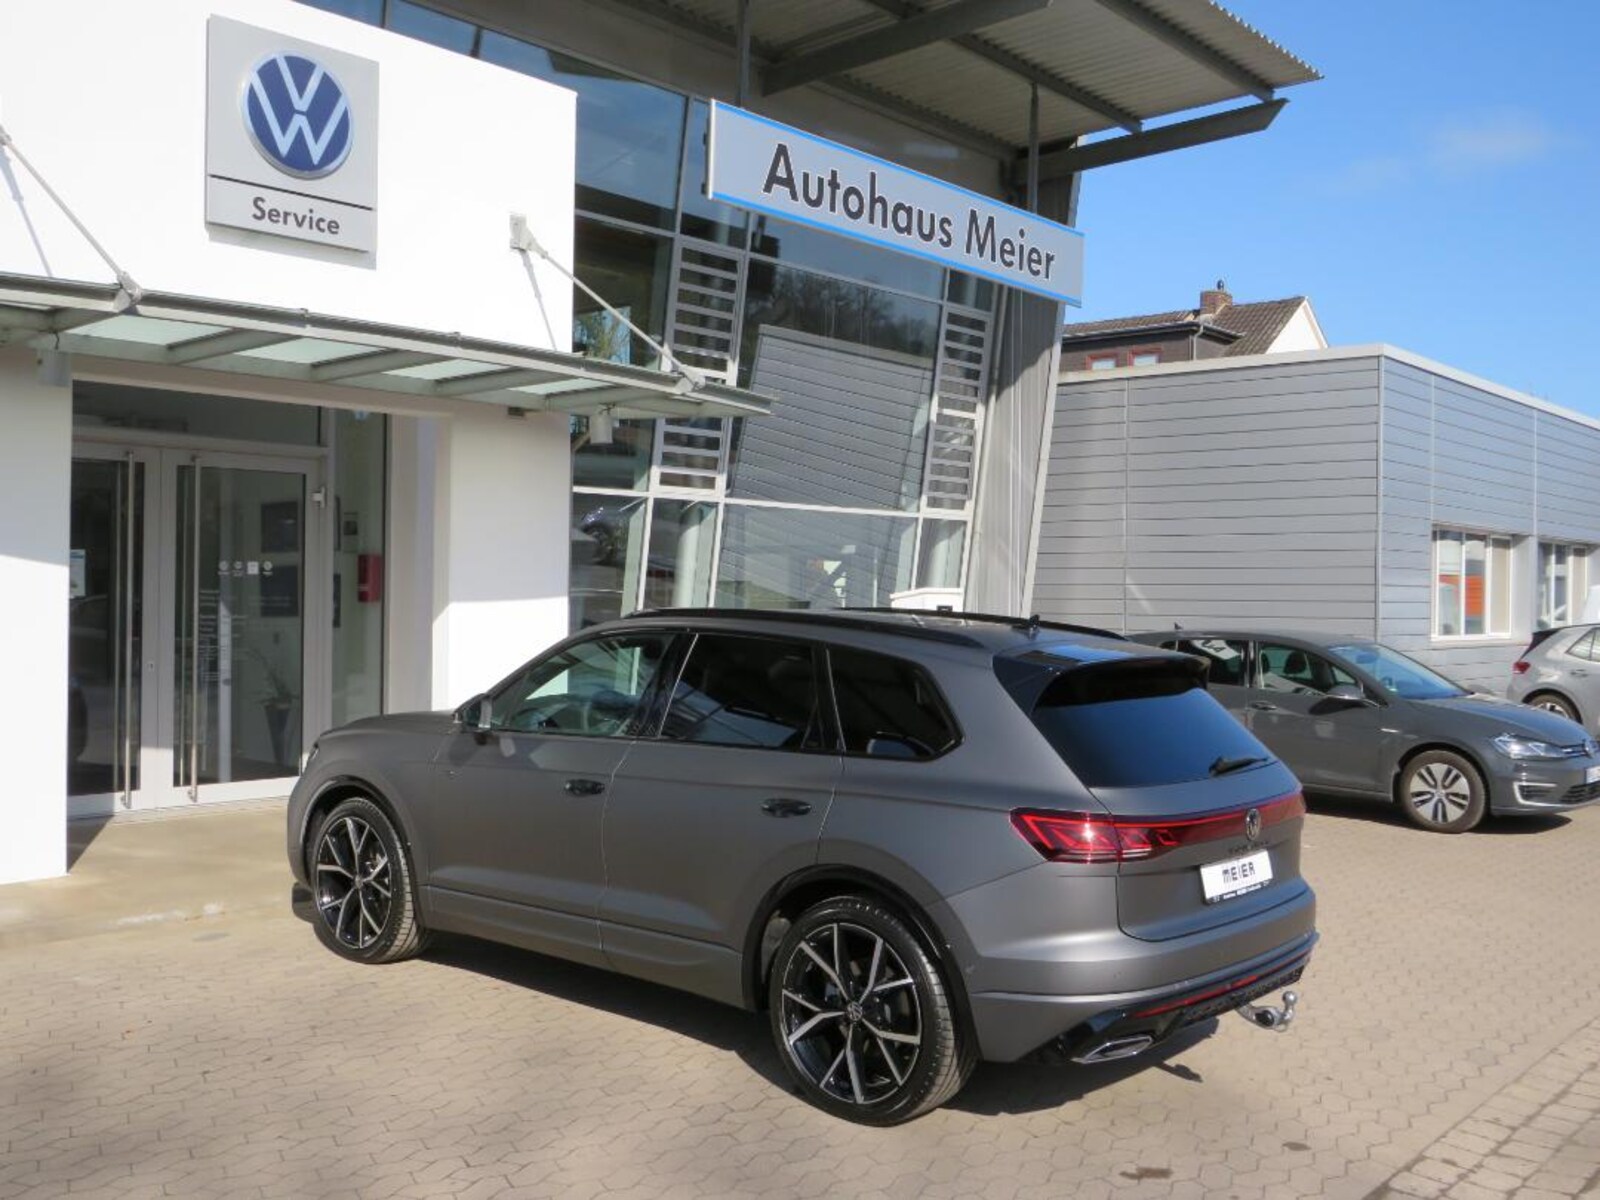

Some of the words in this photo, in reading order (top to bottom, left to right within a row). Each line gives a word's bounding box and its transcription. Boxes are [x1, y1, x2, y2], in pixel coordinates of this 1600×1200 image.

[252, 196, 341, 235] Service
[763, 142, 954, 249] Autohaus
[965, 208, 1056, 280] Meier
[1222, 861, 1256, 883] MEIER
